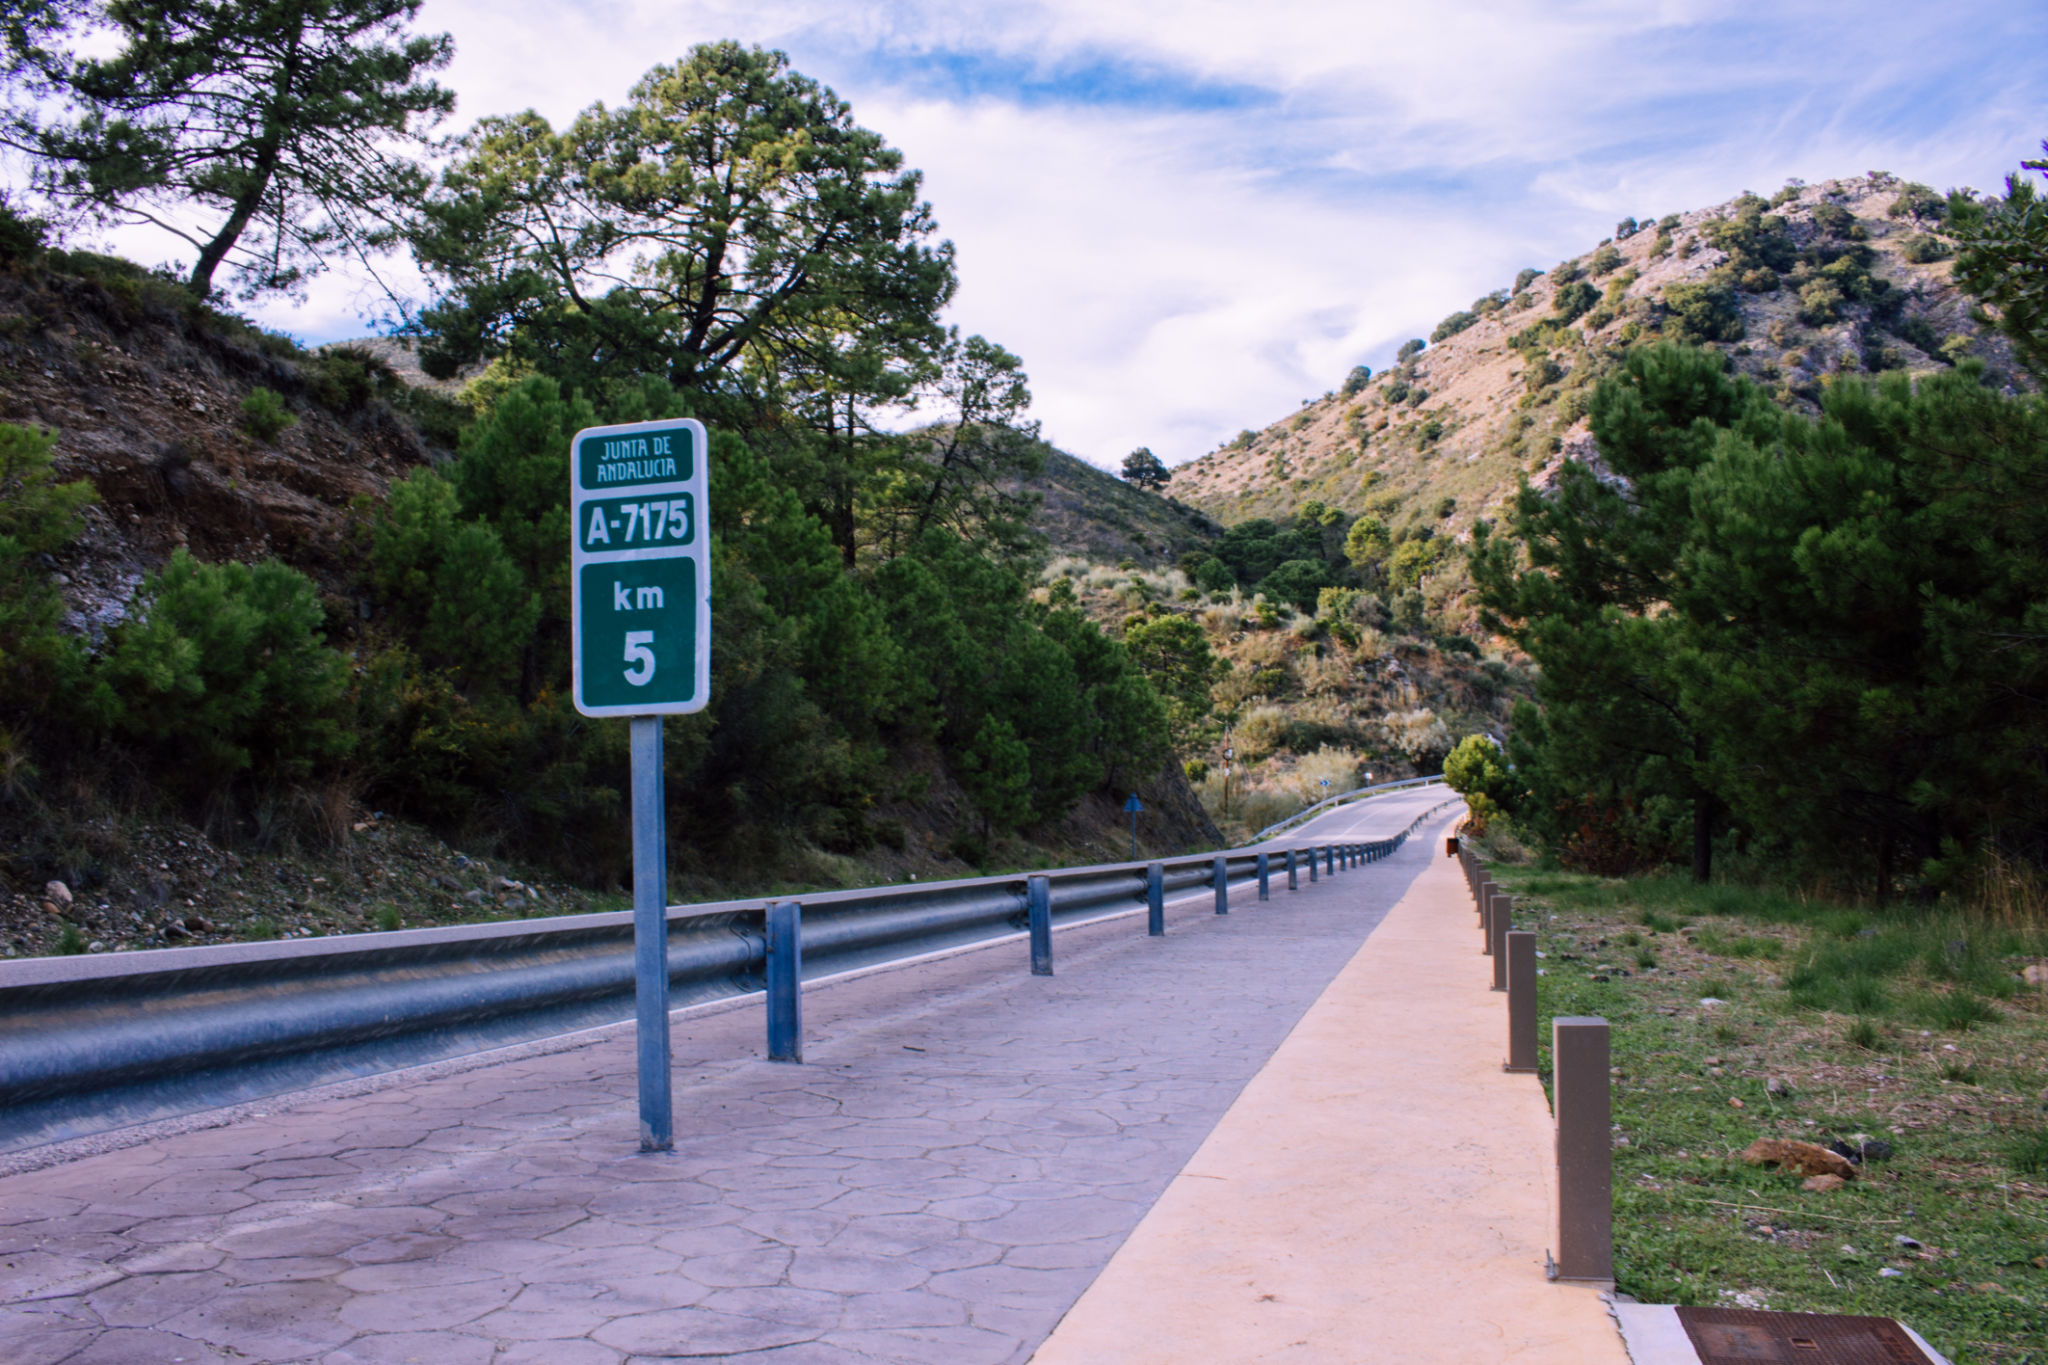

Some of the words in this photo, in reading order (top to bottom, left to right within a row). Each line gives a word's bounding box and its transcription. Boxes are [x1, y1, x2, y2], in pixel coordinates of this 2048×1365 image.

[601, 439, 648, 460] JUNTA
[653, 436, 672, 455] DE
[597, 458, 677, 482] ANDALUCIA
[587, 499, 688, 545] A-7175
[614, 581, 664, 611] km
[623, 630, 656, 686] 5
